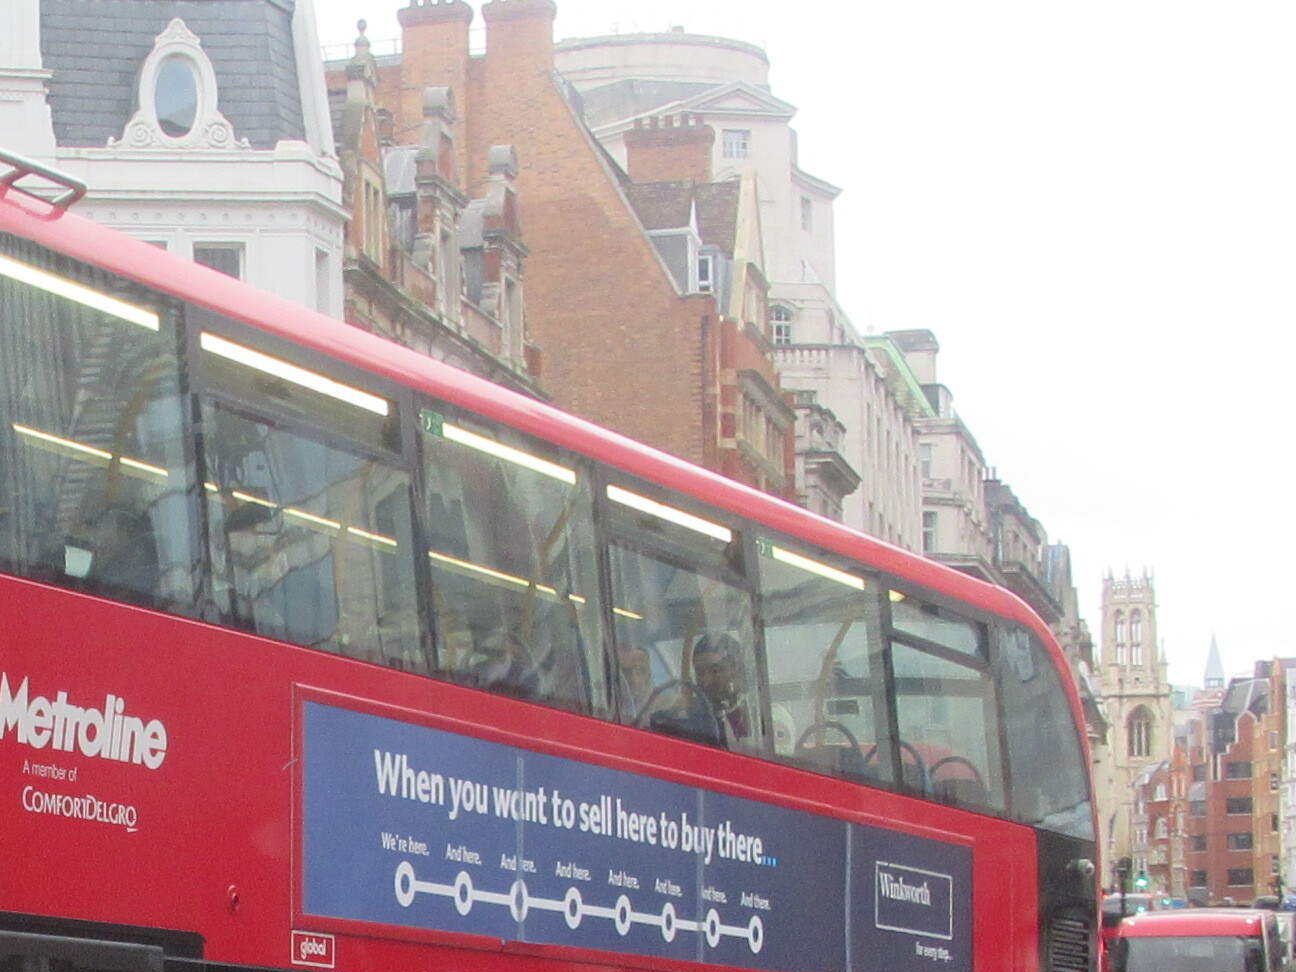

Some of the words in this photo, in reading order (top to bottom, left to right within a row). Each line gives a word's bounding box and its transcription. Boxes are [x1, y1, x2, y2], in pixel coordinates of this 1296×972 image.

[22, 760, 30, 774] A
[31, 763, 67, 781] member
[68, 767, 78, 782] of
[374, 749, 444, 806] When
[449, 776, 489, 820] you
[492, 786, 548, 825] want
[552, 789, 576, 830] to
[578, 795, 613, 837] sell
[616, 797, 657, 846] here
[660, 811, 678, 850] to
[681, 812, 715, 865] buy
[717, 820, 778, 868] there...
[380, 831, 407, 851] We're
[408, 835, 430, 856] here.
[445, 843, 461, 861] And
[462, 846, 483, 866] here.
[500, 853, 516, 871] And
[556, 861, 571, 878] And
[572, 864, 591, 882] here.
[608, 869, 622, 887] And
[623, 872, 640, 890] here.
[655, 878, 668, 894] And
[668, 880, 683, 898] here.
[714, 888, 728, 904] here.
[879, 871, 931, 907] Winkworth
[740, 891, 753, 907] And
[754, 893, 771, 911] there.
[300, 937, 326, 959] global
